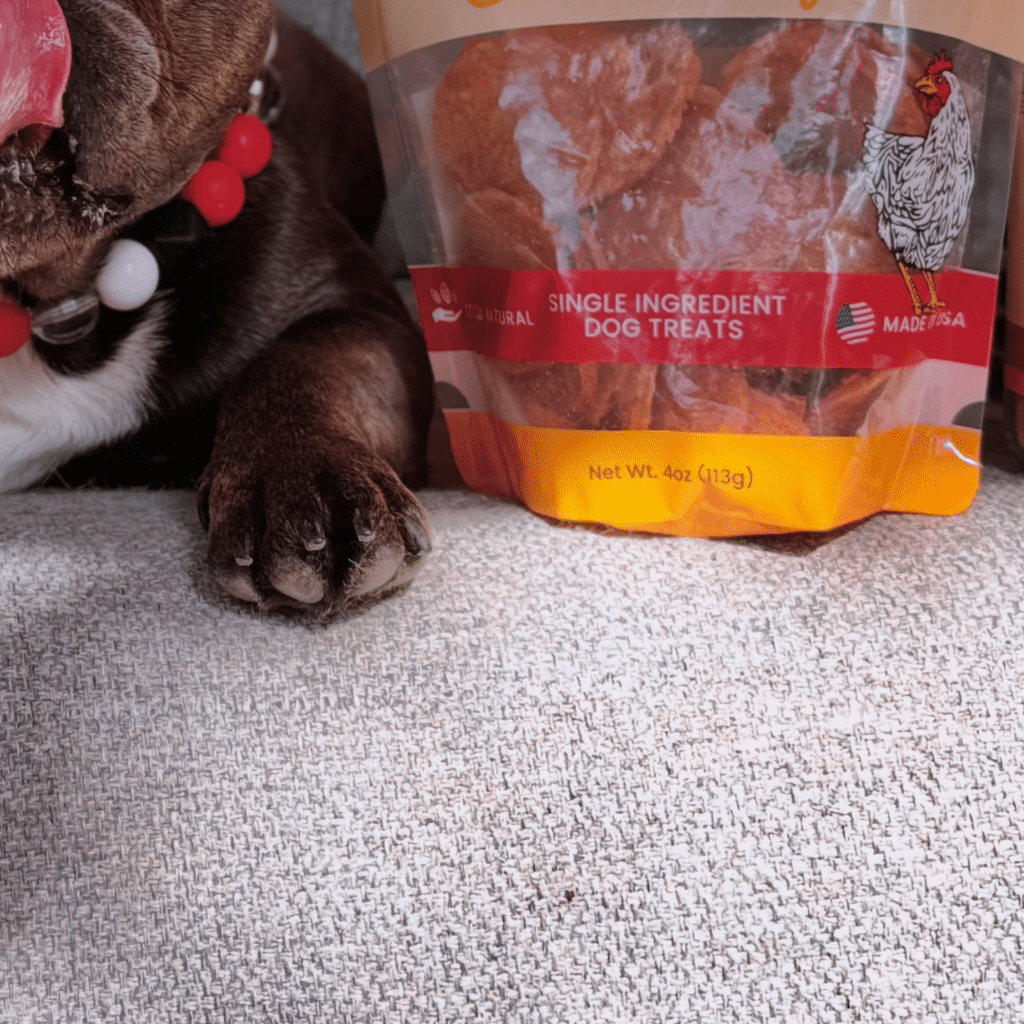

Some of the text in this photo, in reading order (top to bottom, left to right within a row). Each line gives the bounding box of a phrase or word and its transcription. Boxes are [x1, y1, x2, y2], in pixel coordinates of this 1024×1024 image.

[548, 292, 787, 316] SINGLE INGREDIENT
[584, 316, 745, 340] DOG TREATS
[882, 315, 928, 333] MADE
[588, 463, 754, 490] Net Wt. 4oz (113g)
